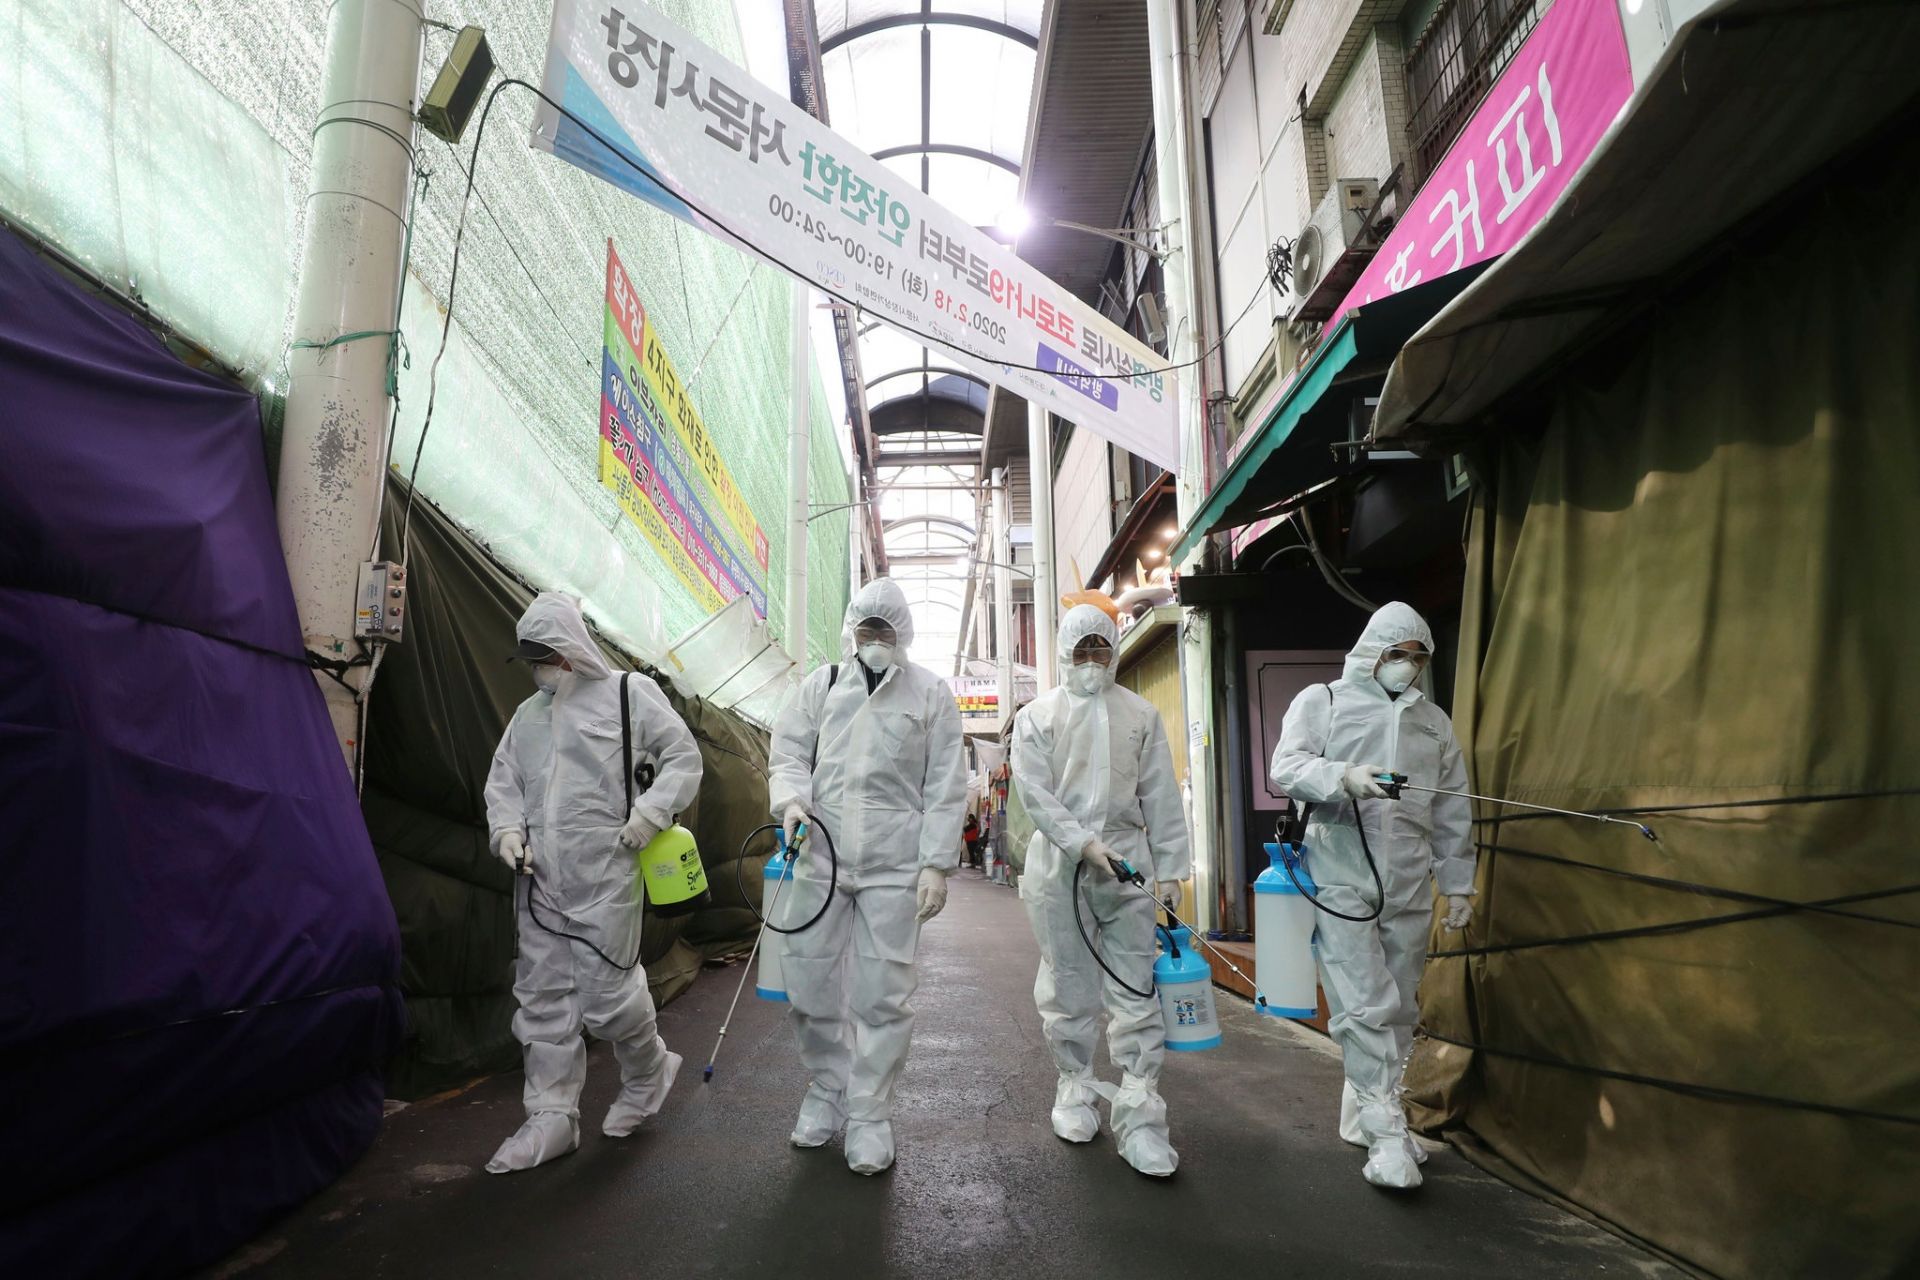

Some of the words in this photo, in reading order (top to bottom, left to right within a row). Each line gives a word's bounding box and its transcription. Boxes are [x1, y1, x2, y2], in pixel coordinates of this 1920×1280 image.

[1430, 61, 1563, 271] 커피
[612, 263, 643, 347] 확장
[647, 337, 676, 406] 4지구
[677, 389, 702, 458] 화재로
[704, 440, 719, 487] 인한
